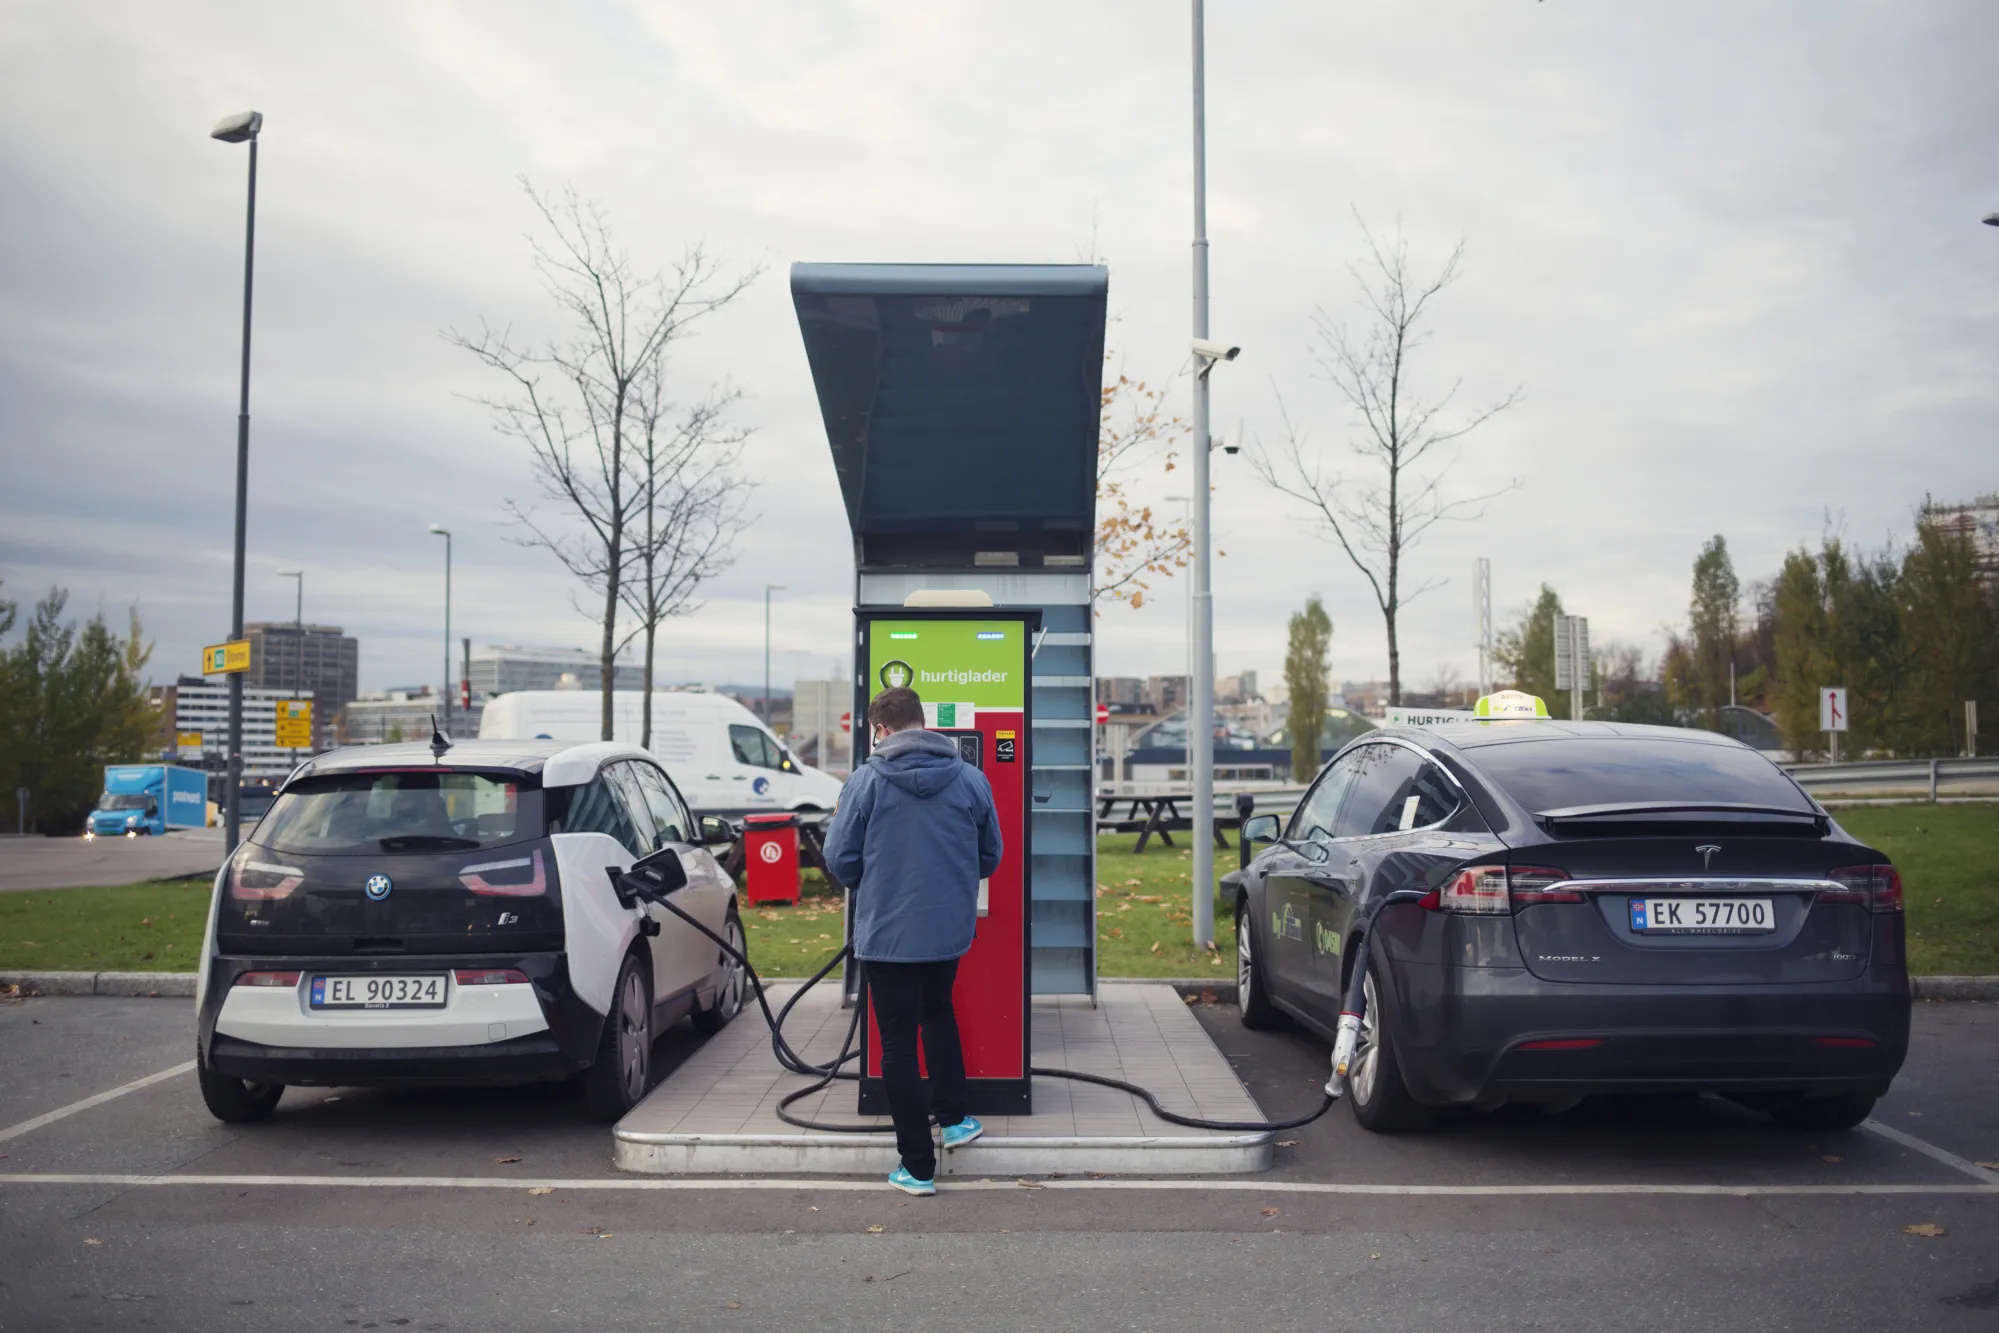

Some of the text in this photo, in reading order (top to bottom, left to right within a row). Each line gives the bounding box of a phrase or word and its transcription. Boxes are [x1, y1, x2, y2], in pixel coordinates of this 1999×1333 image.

[921, 669, 1008, 685] hurtiglader
[1636, 917, 1644, 925] N
[1653, 903, 1765, 925] EK 57700
[332, 980, 438, 1001] EL 90324
